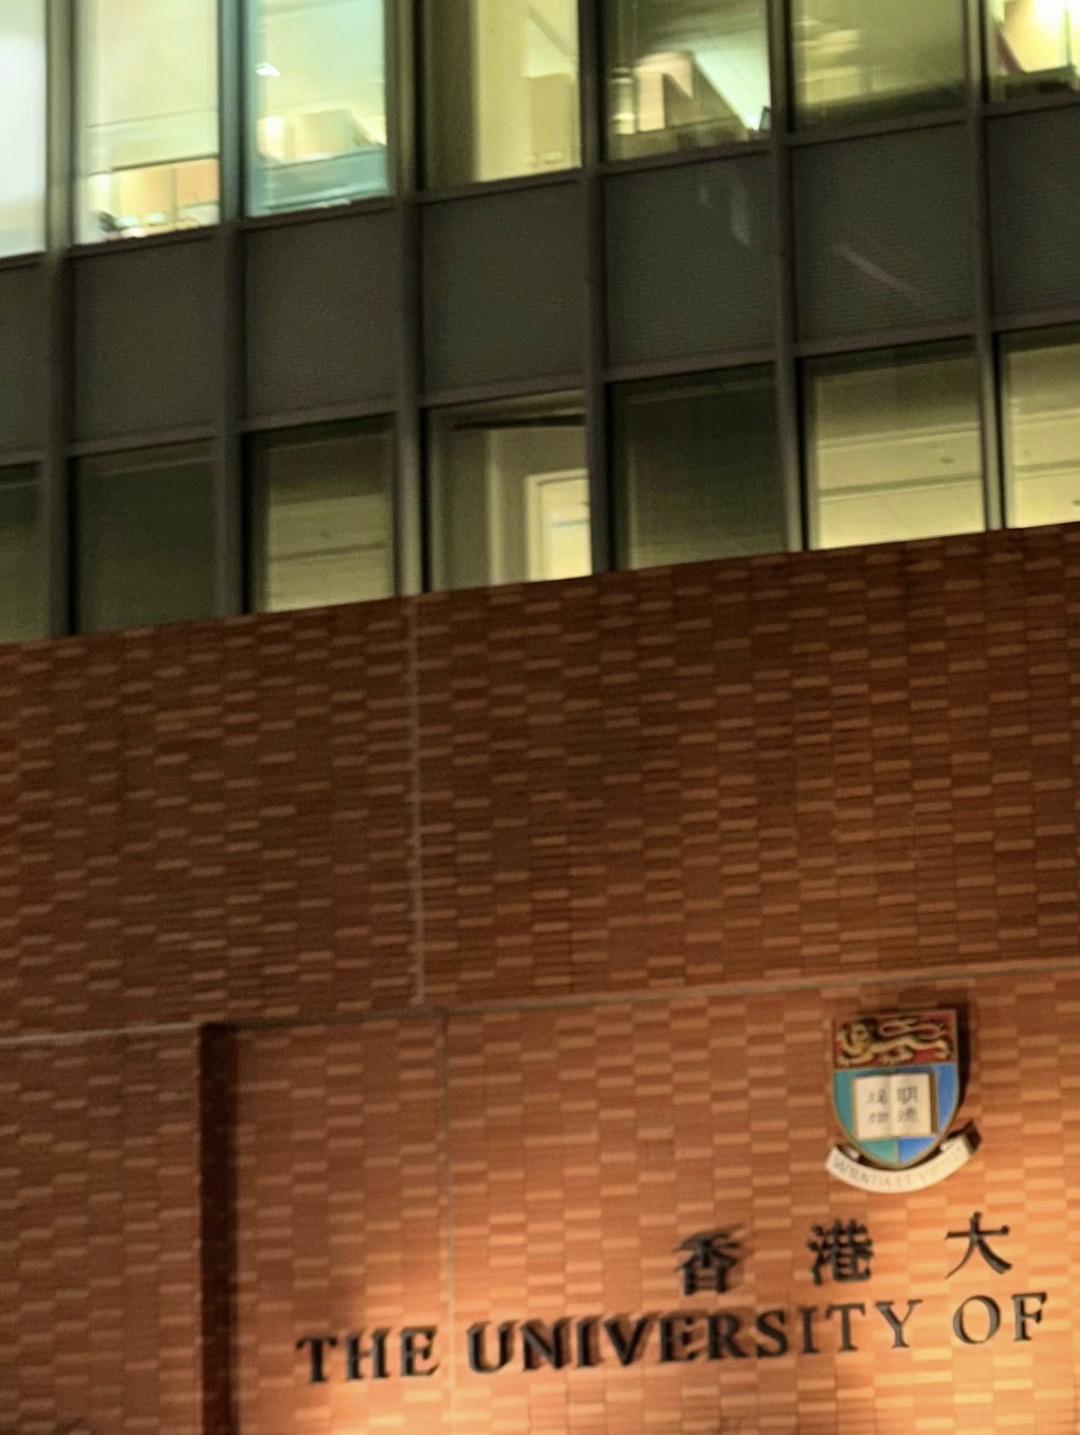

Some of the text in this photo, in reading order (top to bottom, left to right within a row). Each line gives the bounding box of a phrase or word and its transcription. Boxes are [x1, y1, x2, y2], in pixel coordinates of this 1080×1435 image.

[296, 1325, 439, 1384] THE
[467, 1299, 921, 1373] UNIVERSITY
[952, 1292, 1047, 1345] OF
